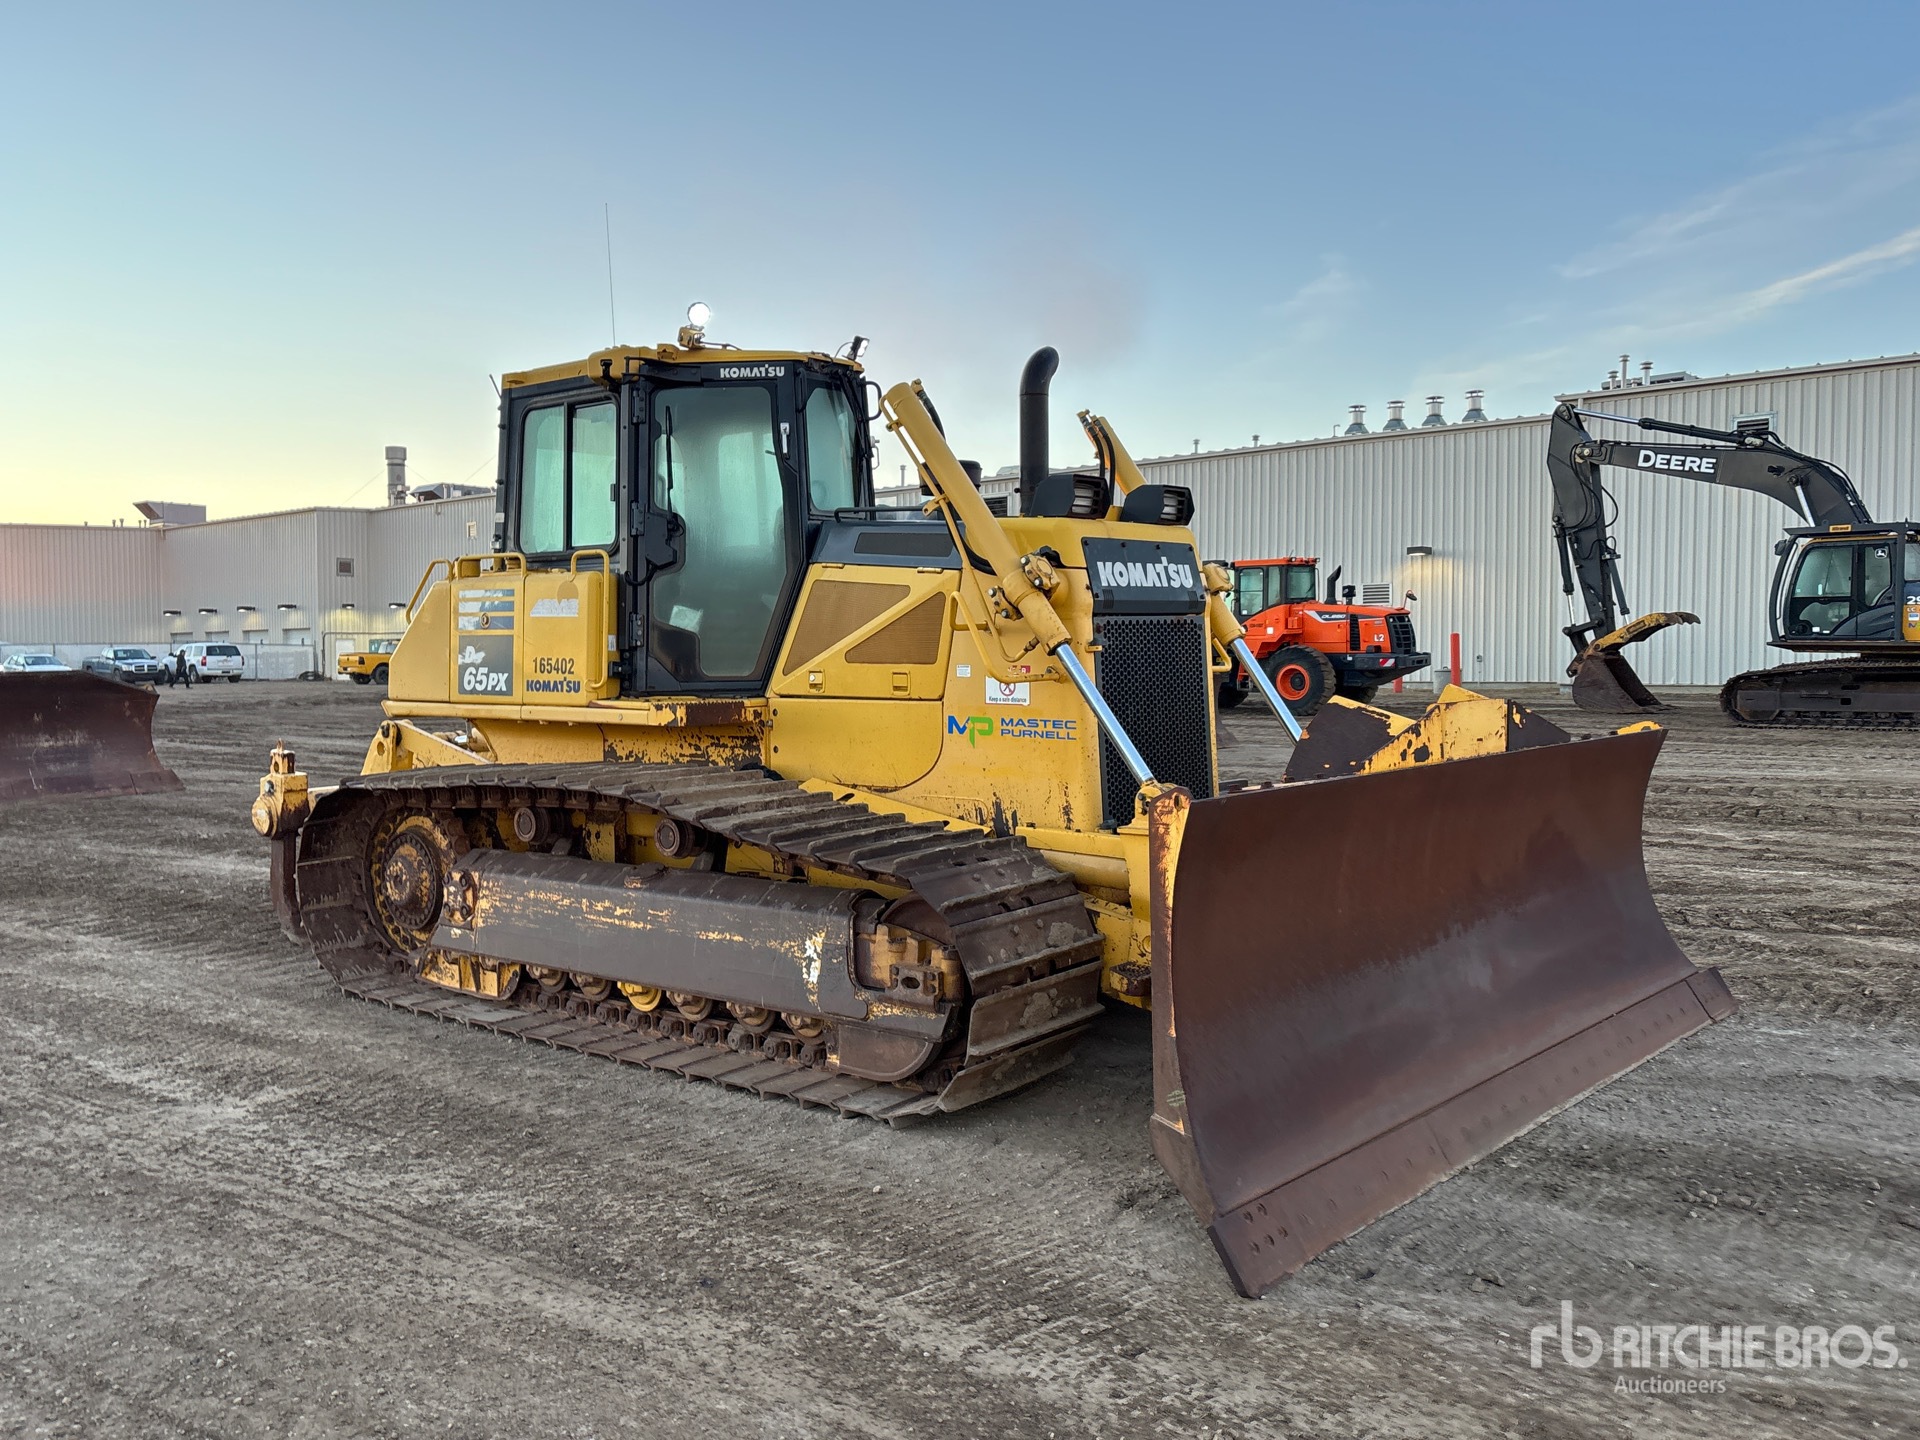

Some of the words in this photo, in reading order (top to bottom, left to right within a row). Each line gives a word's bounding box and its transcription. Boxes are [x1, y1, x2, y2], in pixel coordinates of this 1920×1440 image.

[720, 364, 785, 378] KOMATSU
[1637, 449, 1717, 473] DEERE
[1097, 556, 1193, 588] KOMATSU
[1374, 634, 1385, 642] L2
[532, 657, 575, 674] 165402
[463, 667, 508, 691] 65PX
[526, 677, 581, 693] KOMATSU
[1000, 718, 1077, 730] MASTEC
[1000, 729, 1077, 740] PURNELL
